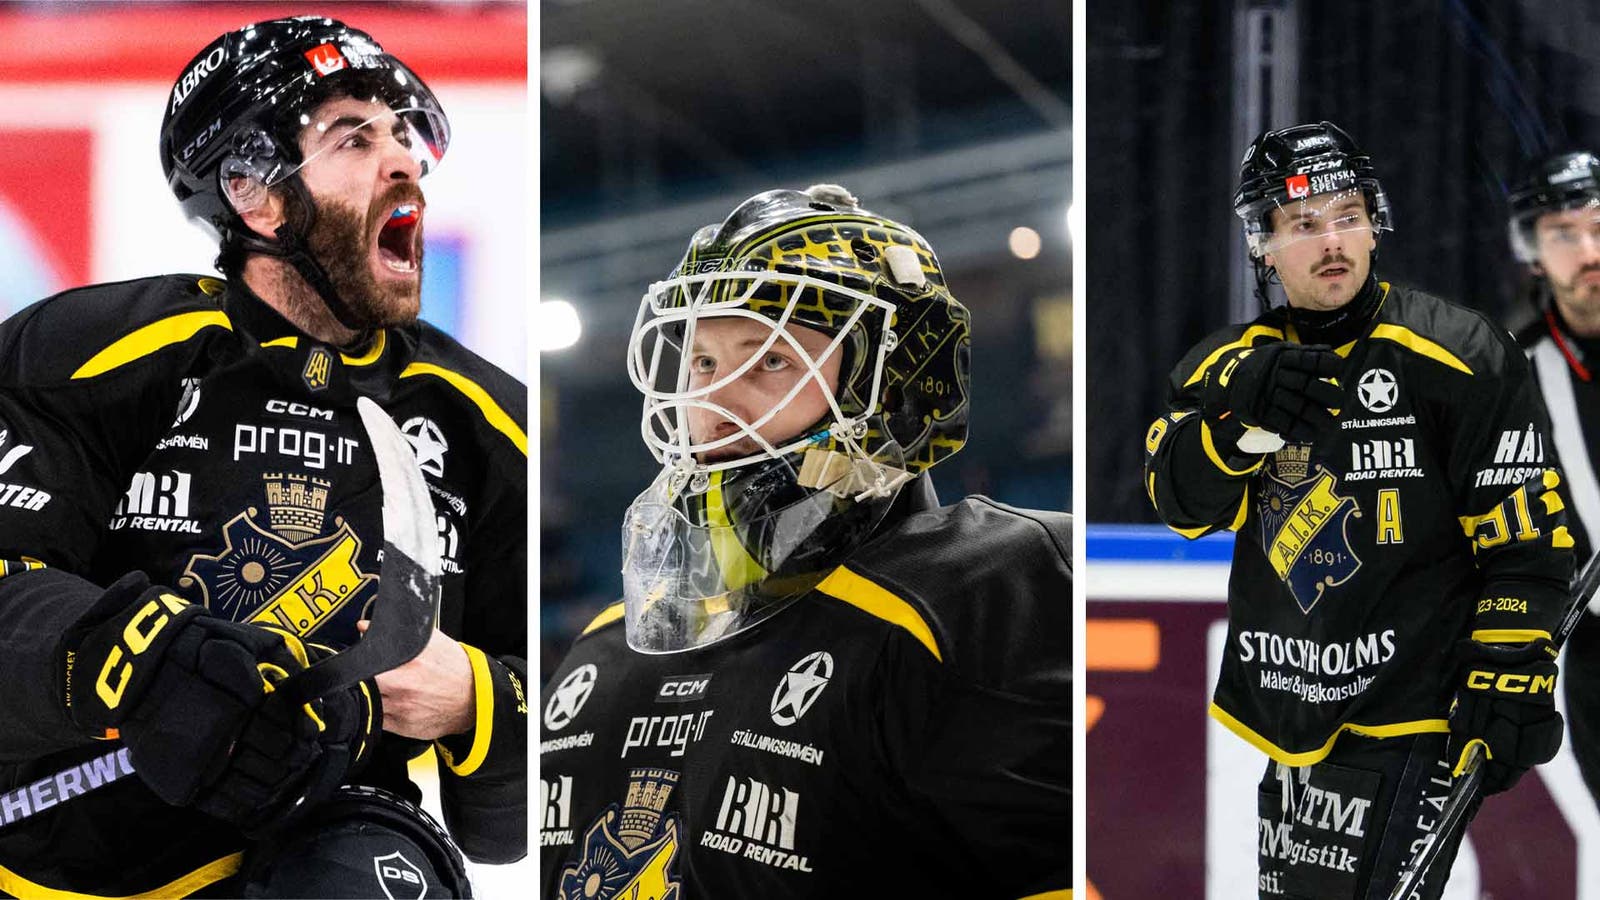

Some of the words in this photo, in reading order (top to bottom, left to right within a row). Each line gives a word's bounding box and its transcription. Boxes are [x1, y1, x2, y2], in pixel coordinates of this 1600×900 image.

[182, 118, 222, 160] CCM
[1310, 169, 1357, 186] SVENSKA
[1312, 183, 1339, 195] SPEL
[265, 399, 334, 421] CCM
[1344, 471, 1377, 481] ROAD
[1379, 468, 1424, 479] RENTAL
[129, 516, 203, 534] RENTAL
[1377, 488, 1404, 544] A
[1309, 548, 1341, 566] 1891
[659, 679, 710, 697] CCM
[1466, 669, 1554, 694] CCM
[699, 831, 743, 855] ROAD
[743, 842, 813, 873] RENTAL
[383, 865, 421, 885] DS
